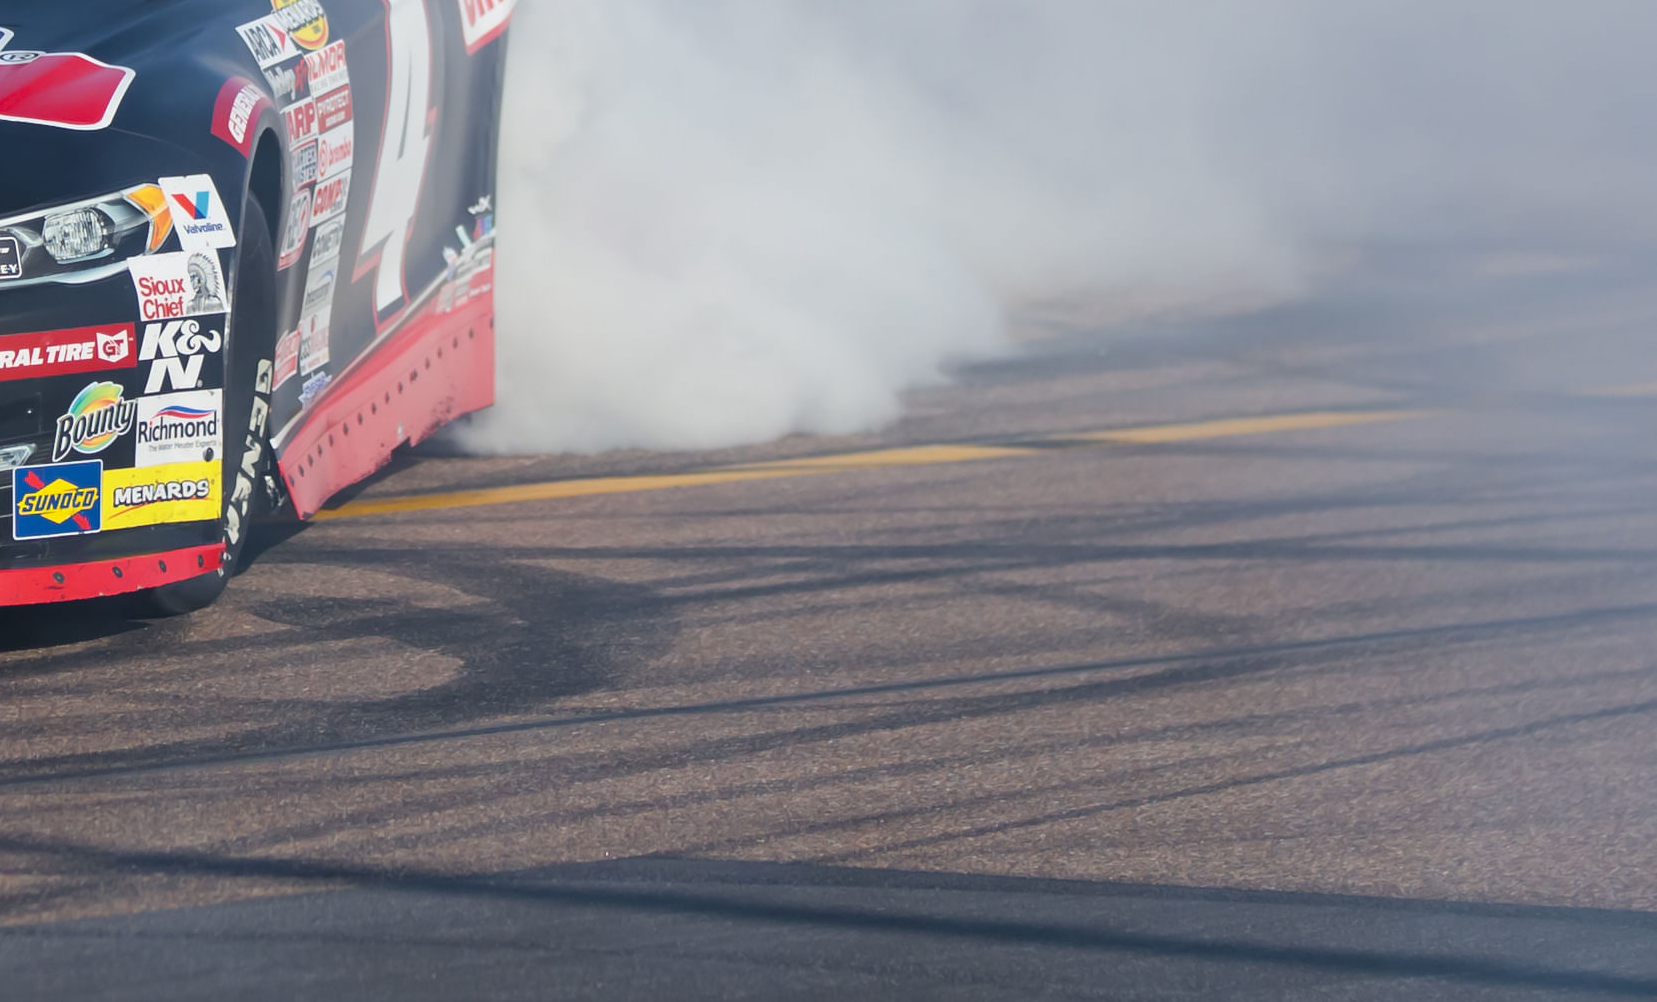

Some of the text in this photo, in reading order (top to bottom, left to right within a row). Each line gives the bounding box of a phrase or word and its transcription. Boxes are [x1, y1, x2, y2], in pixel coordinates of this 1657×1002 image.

[244, 24, 281, 62] ARCA
[286, 102, 314, 142] ARP
[183, 222, 223, 235] Valvoline
[139, 277, 186, 296] Sioux
[143, 297, 184, 319] Chief
[46, 342, 96, 364] TIRE
[144, 355, 204, 394] N
[53, 396, 137, 462] Bounty
[138, 411, 216, 444] Richmond
[22, 488, 97, 513] SUNOCO
[113, 480, 209, 508] MENARDS
